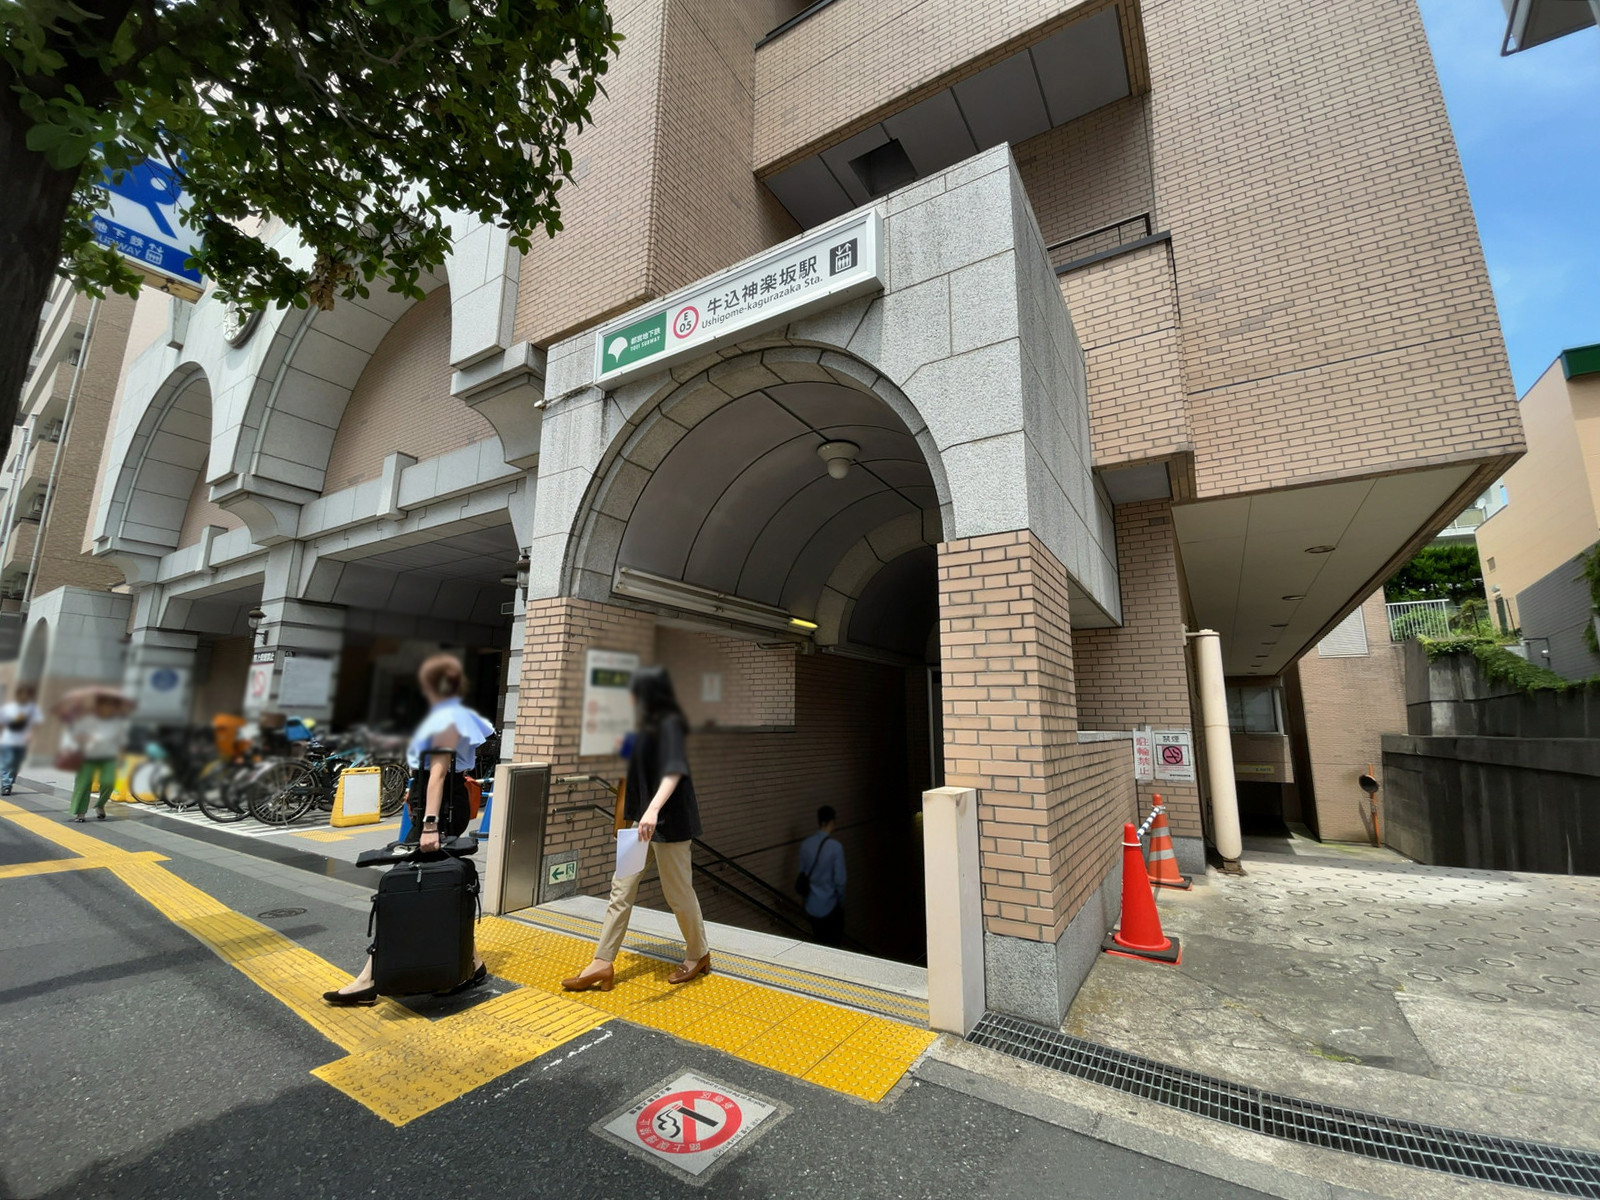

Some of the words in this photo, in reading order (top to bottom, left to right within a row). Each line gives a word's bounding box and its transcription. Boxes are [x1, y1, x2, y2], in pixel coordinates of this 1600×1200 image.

[95, 220, 144, 248] 地下鉄
[96, 234, 142, 256] UBWAY
[707, 256, 817, 315] 牛込神楽坂駅
[701, 284, 801, 329] Ushigome-kagurazaka
[804, 275, 823, 288] Sta.
[679, 320, 692, 333] 05
[683, 311, 690, 321] E
[1162, 735, 1180, 743] 禁煙
[701, 1091, 735, 1110] 新宿区
[638, 1119, 701, 1152] 路上喫煙禁止
